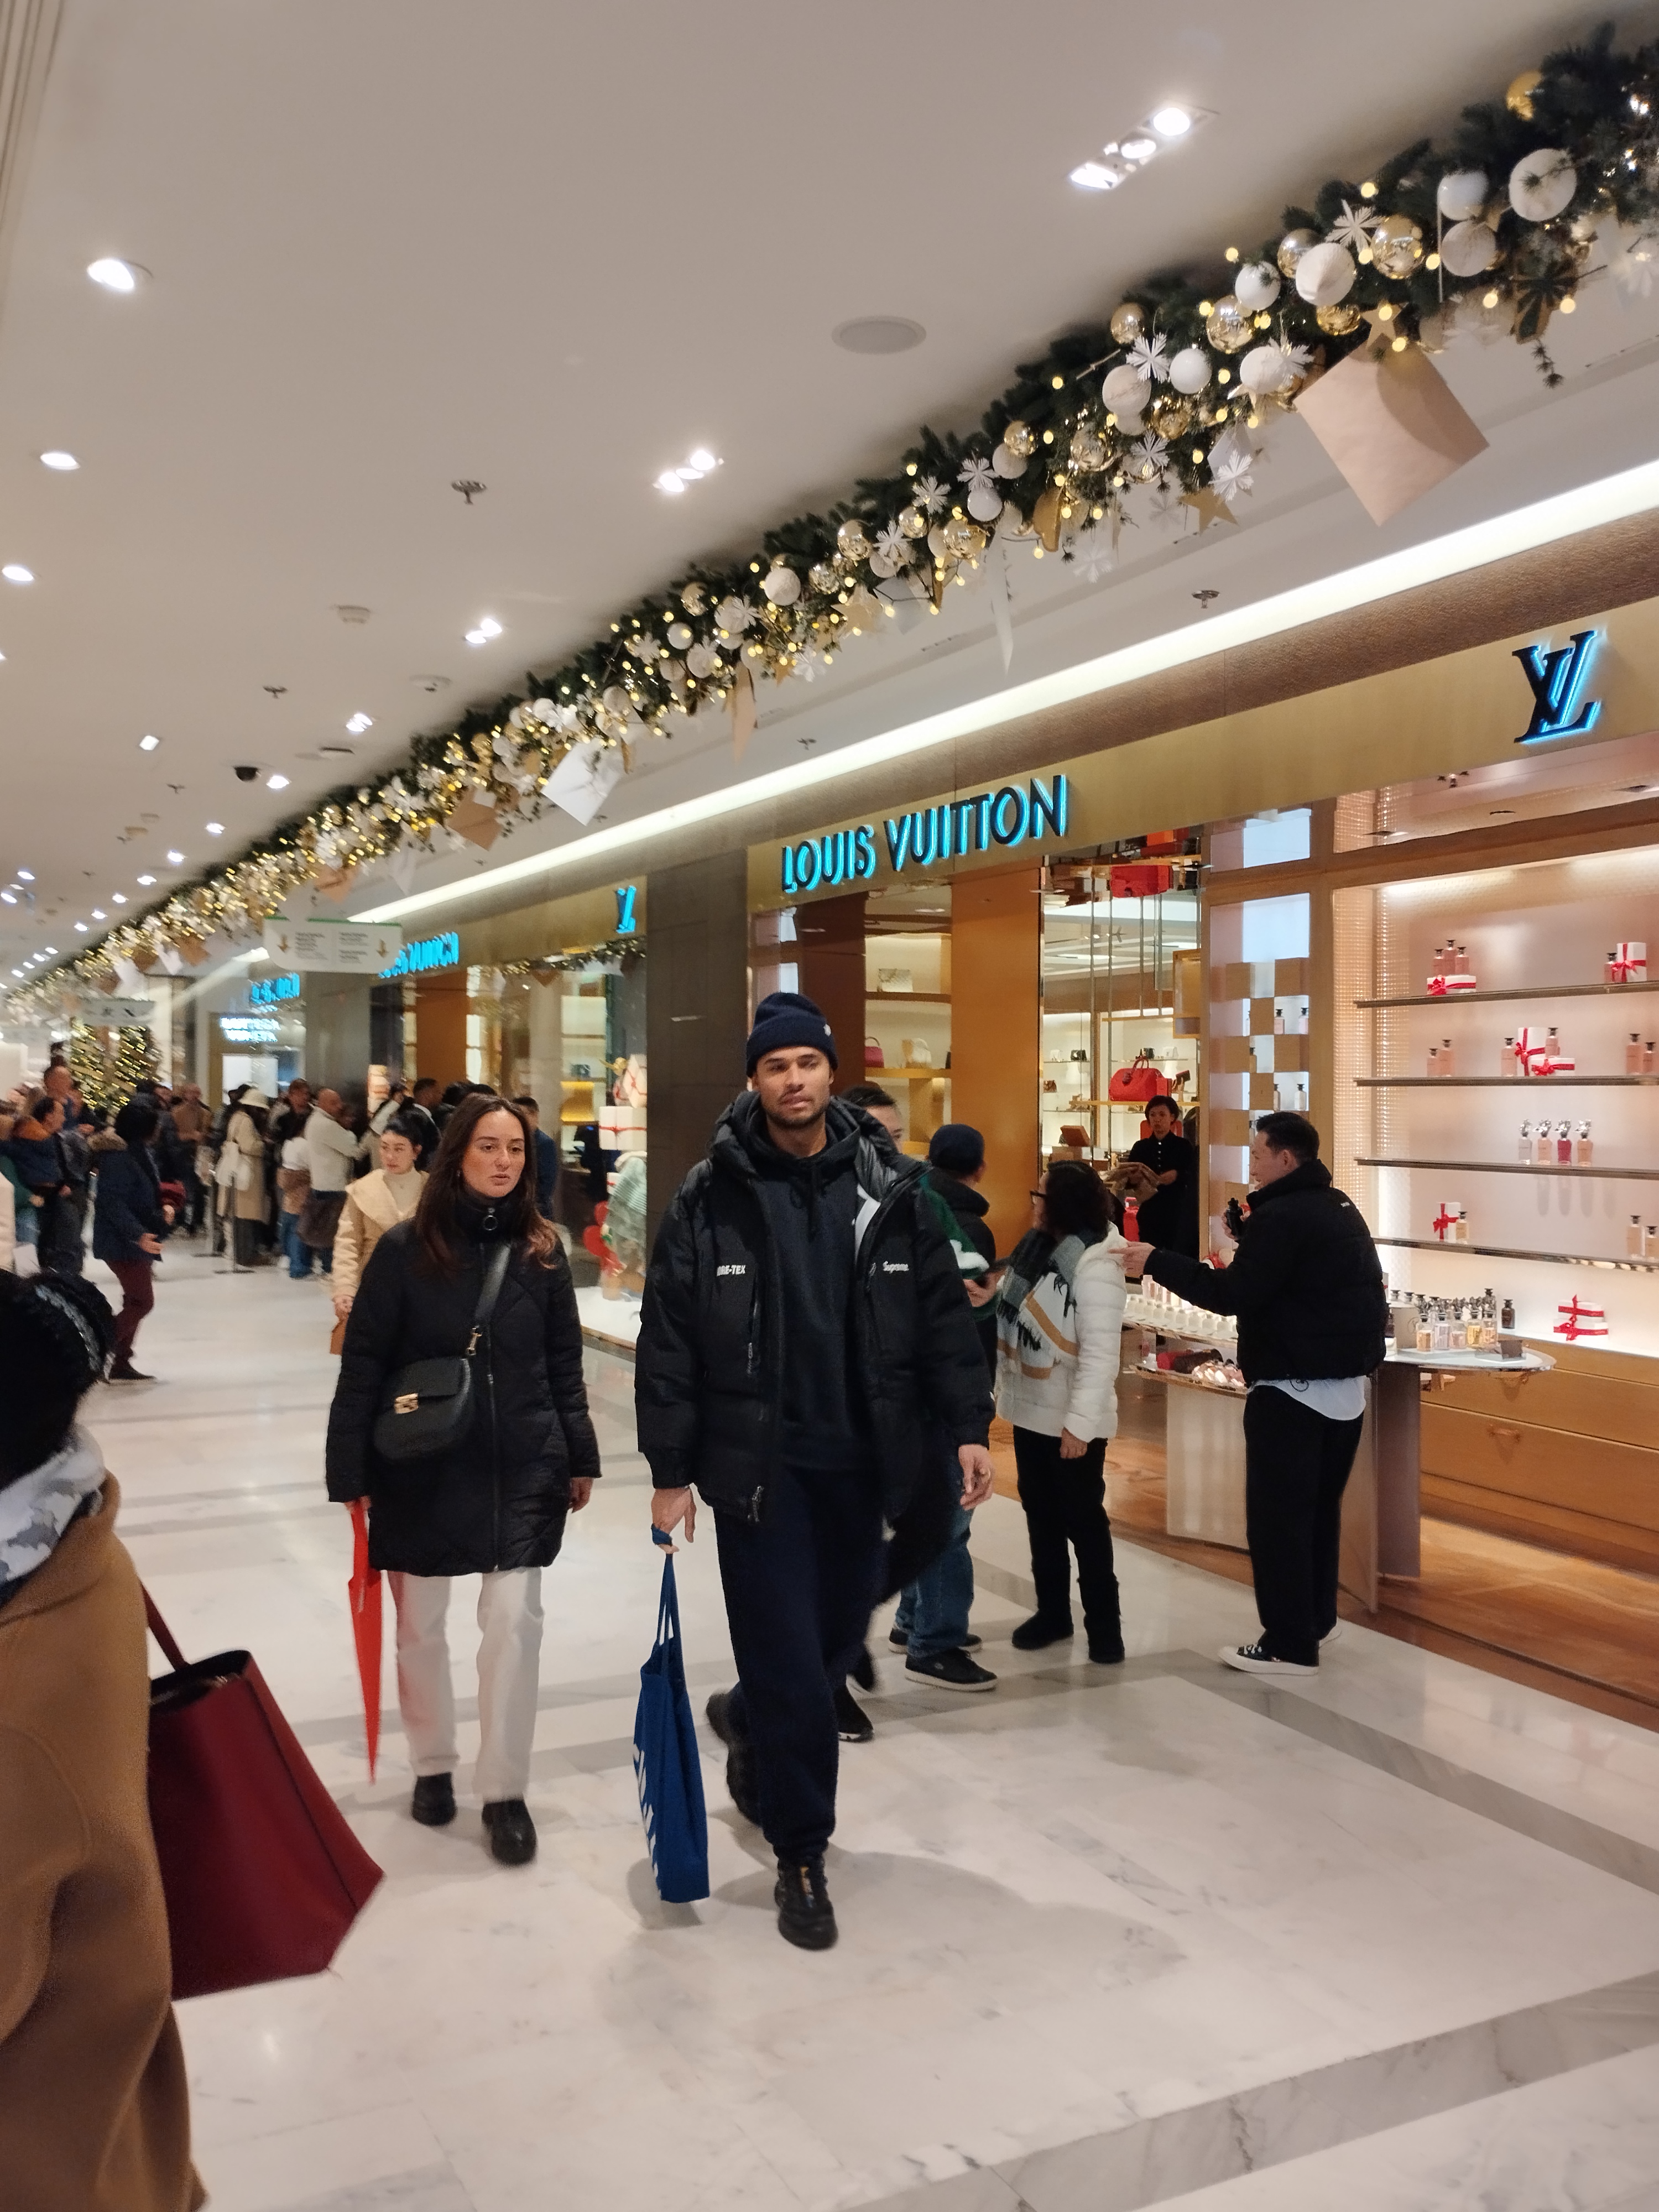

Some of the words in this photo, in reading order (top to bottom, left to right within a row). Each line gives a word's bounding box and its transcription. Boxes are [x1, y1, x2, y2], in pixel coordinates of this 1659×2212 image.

[781, 823, 876, 894] LOUIS
[883, 774, 1067, 873] VUITTON
[717, 1264, 746, 1277] RE-TEX
